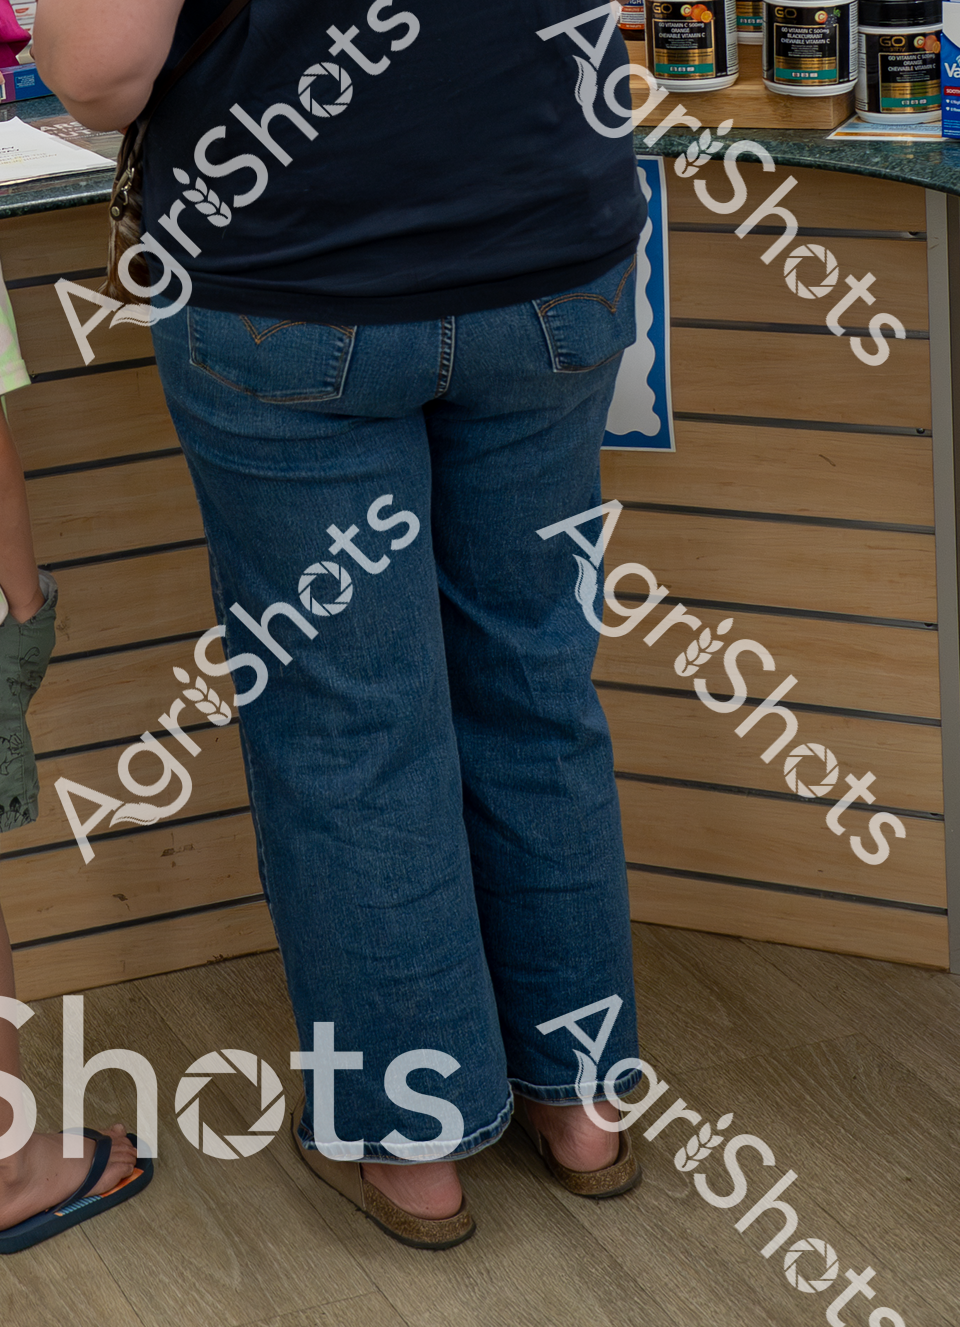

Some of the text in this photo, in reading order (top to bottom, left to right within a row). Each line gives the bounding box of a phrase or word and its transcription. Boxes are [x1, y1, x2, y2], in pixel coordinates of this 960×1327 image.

[653, 3, 672, 13] GO
[775, 7, 797, 18] GO
[880, 36, 905, 46] GO
